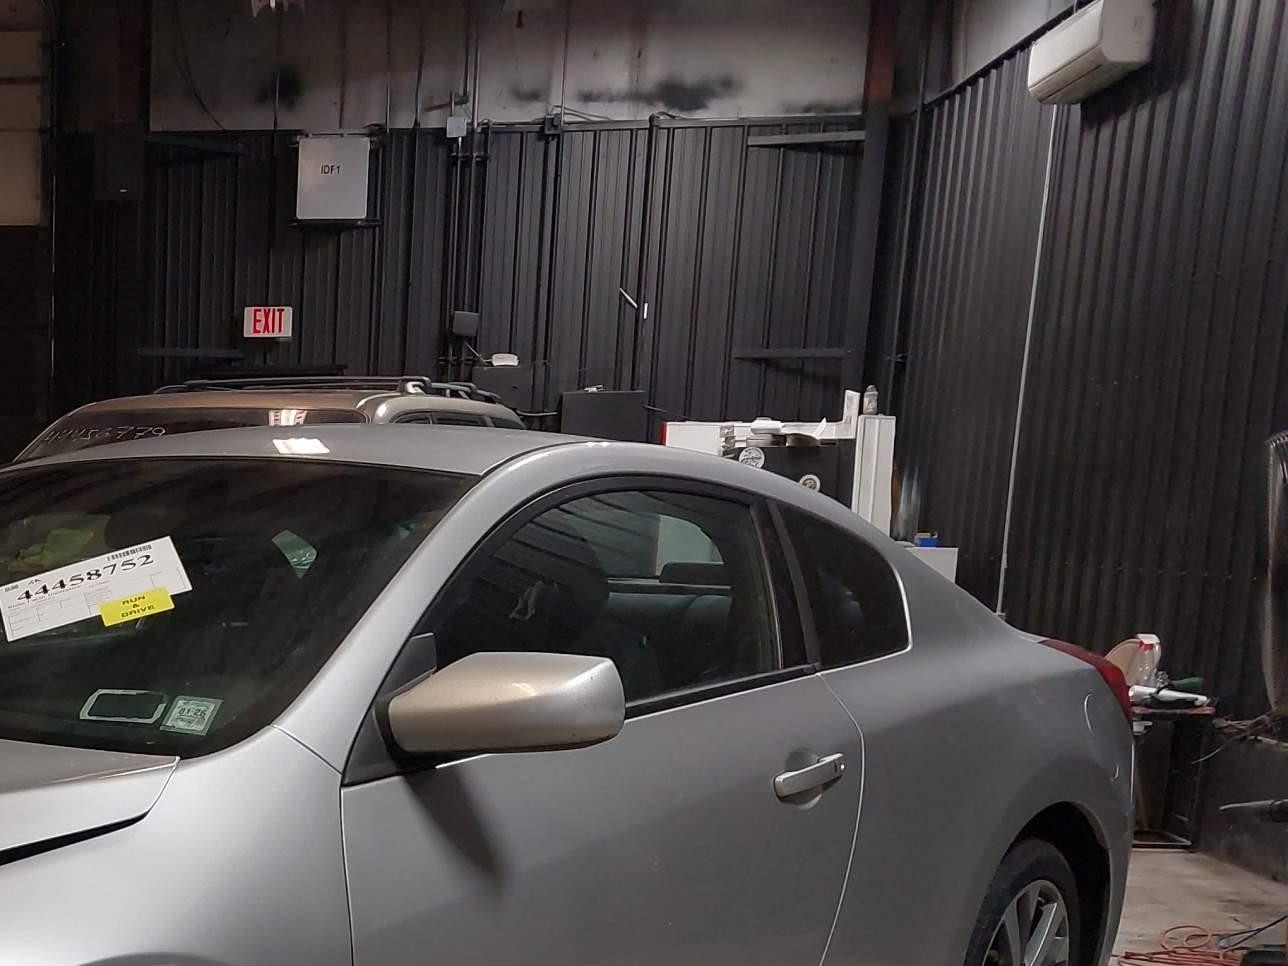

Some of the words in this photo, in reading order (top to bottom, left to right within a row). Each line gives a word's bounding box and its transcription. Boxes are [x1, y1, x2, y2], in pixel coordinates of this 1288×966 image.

[252, 308, 285, 334] EXIT
[17, 554, 154, 600] 44458752
[122, 595, 146, 605] RUN
[121, 605, 155, 617] DRIVE
